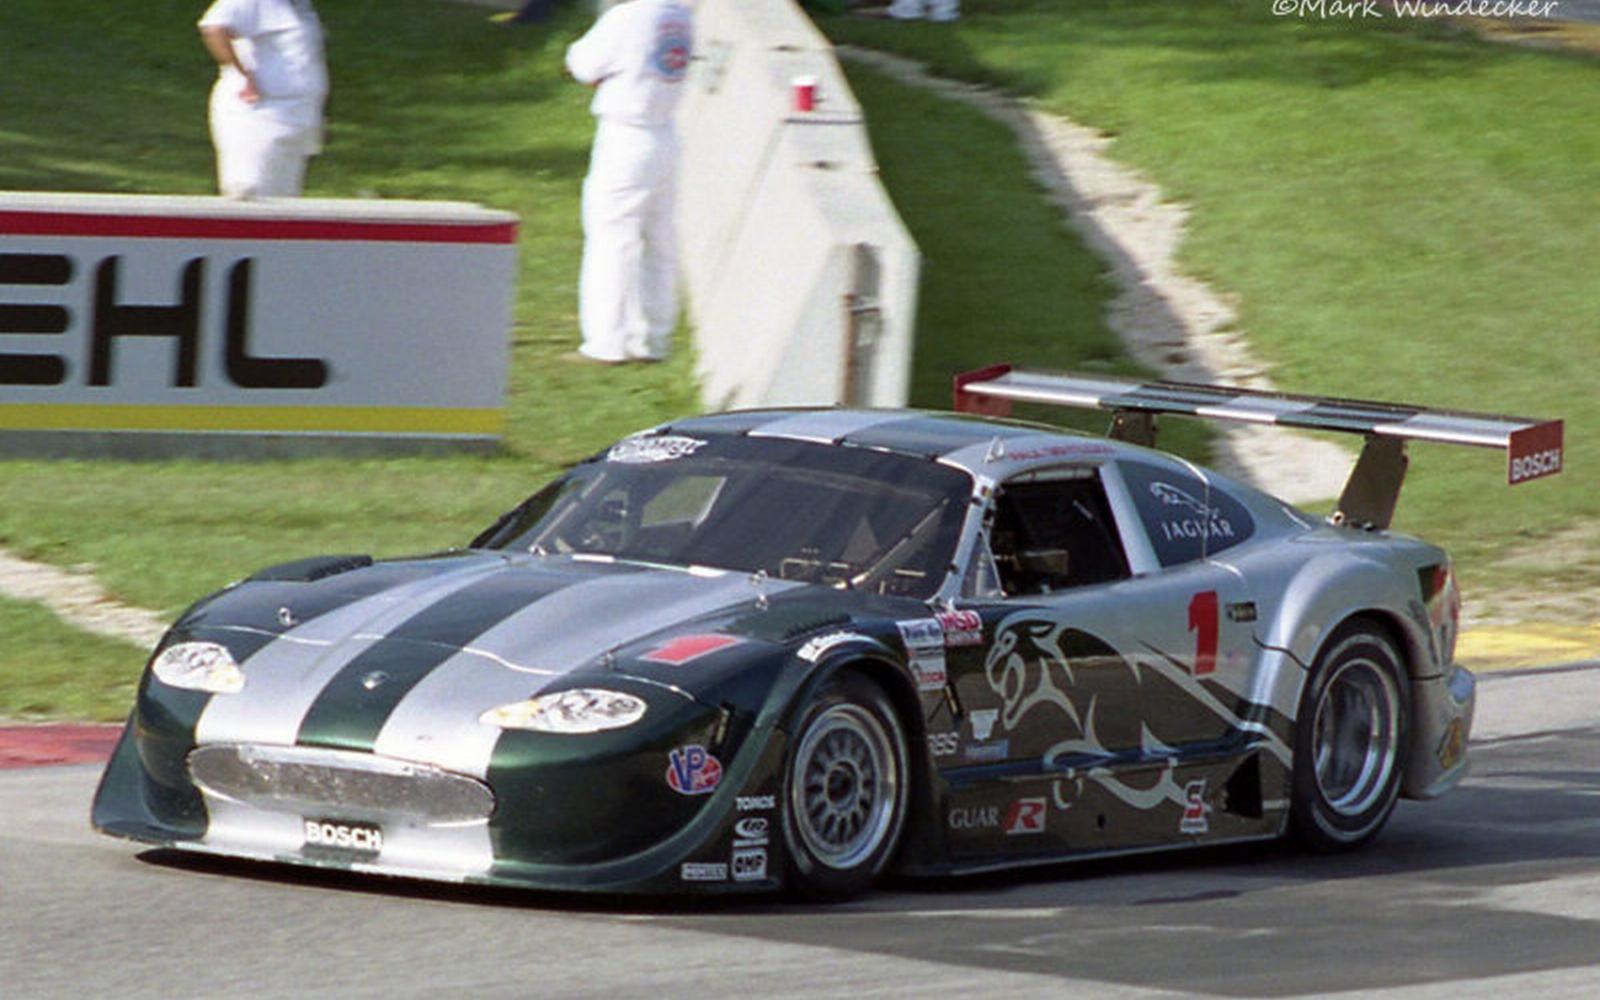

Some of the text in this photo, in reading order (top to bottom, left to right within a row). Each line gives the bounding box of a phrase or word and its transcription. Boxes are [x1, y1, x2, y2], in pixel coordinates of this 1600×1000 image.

[1511, 448, 1560, 480] BOSCH
[1161, 519, 1235, 541] JAGUAR
[1188, 590, 1217, 675] 1
[669, 745, 706, 792] VP
[948, 799, 1047, 834] GUAR R
[305, 821, 381, 850] BOSCH
